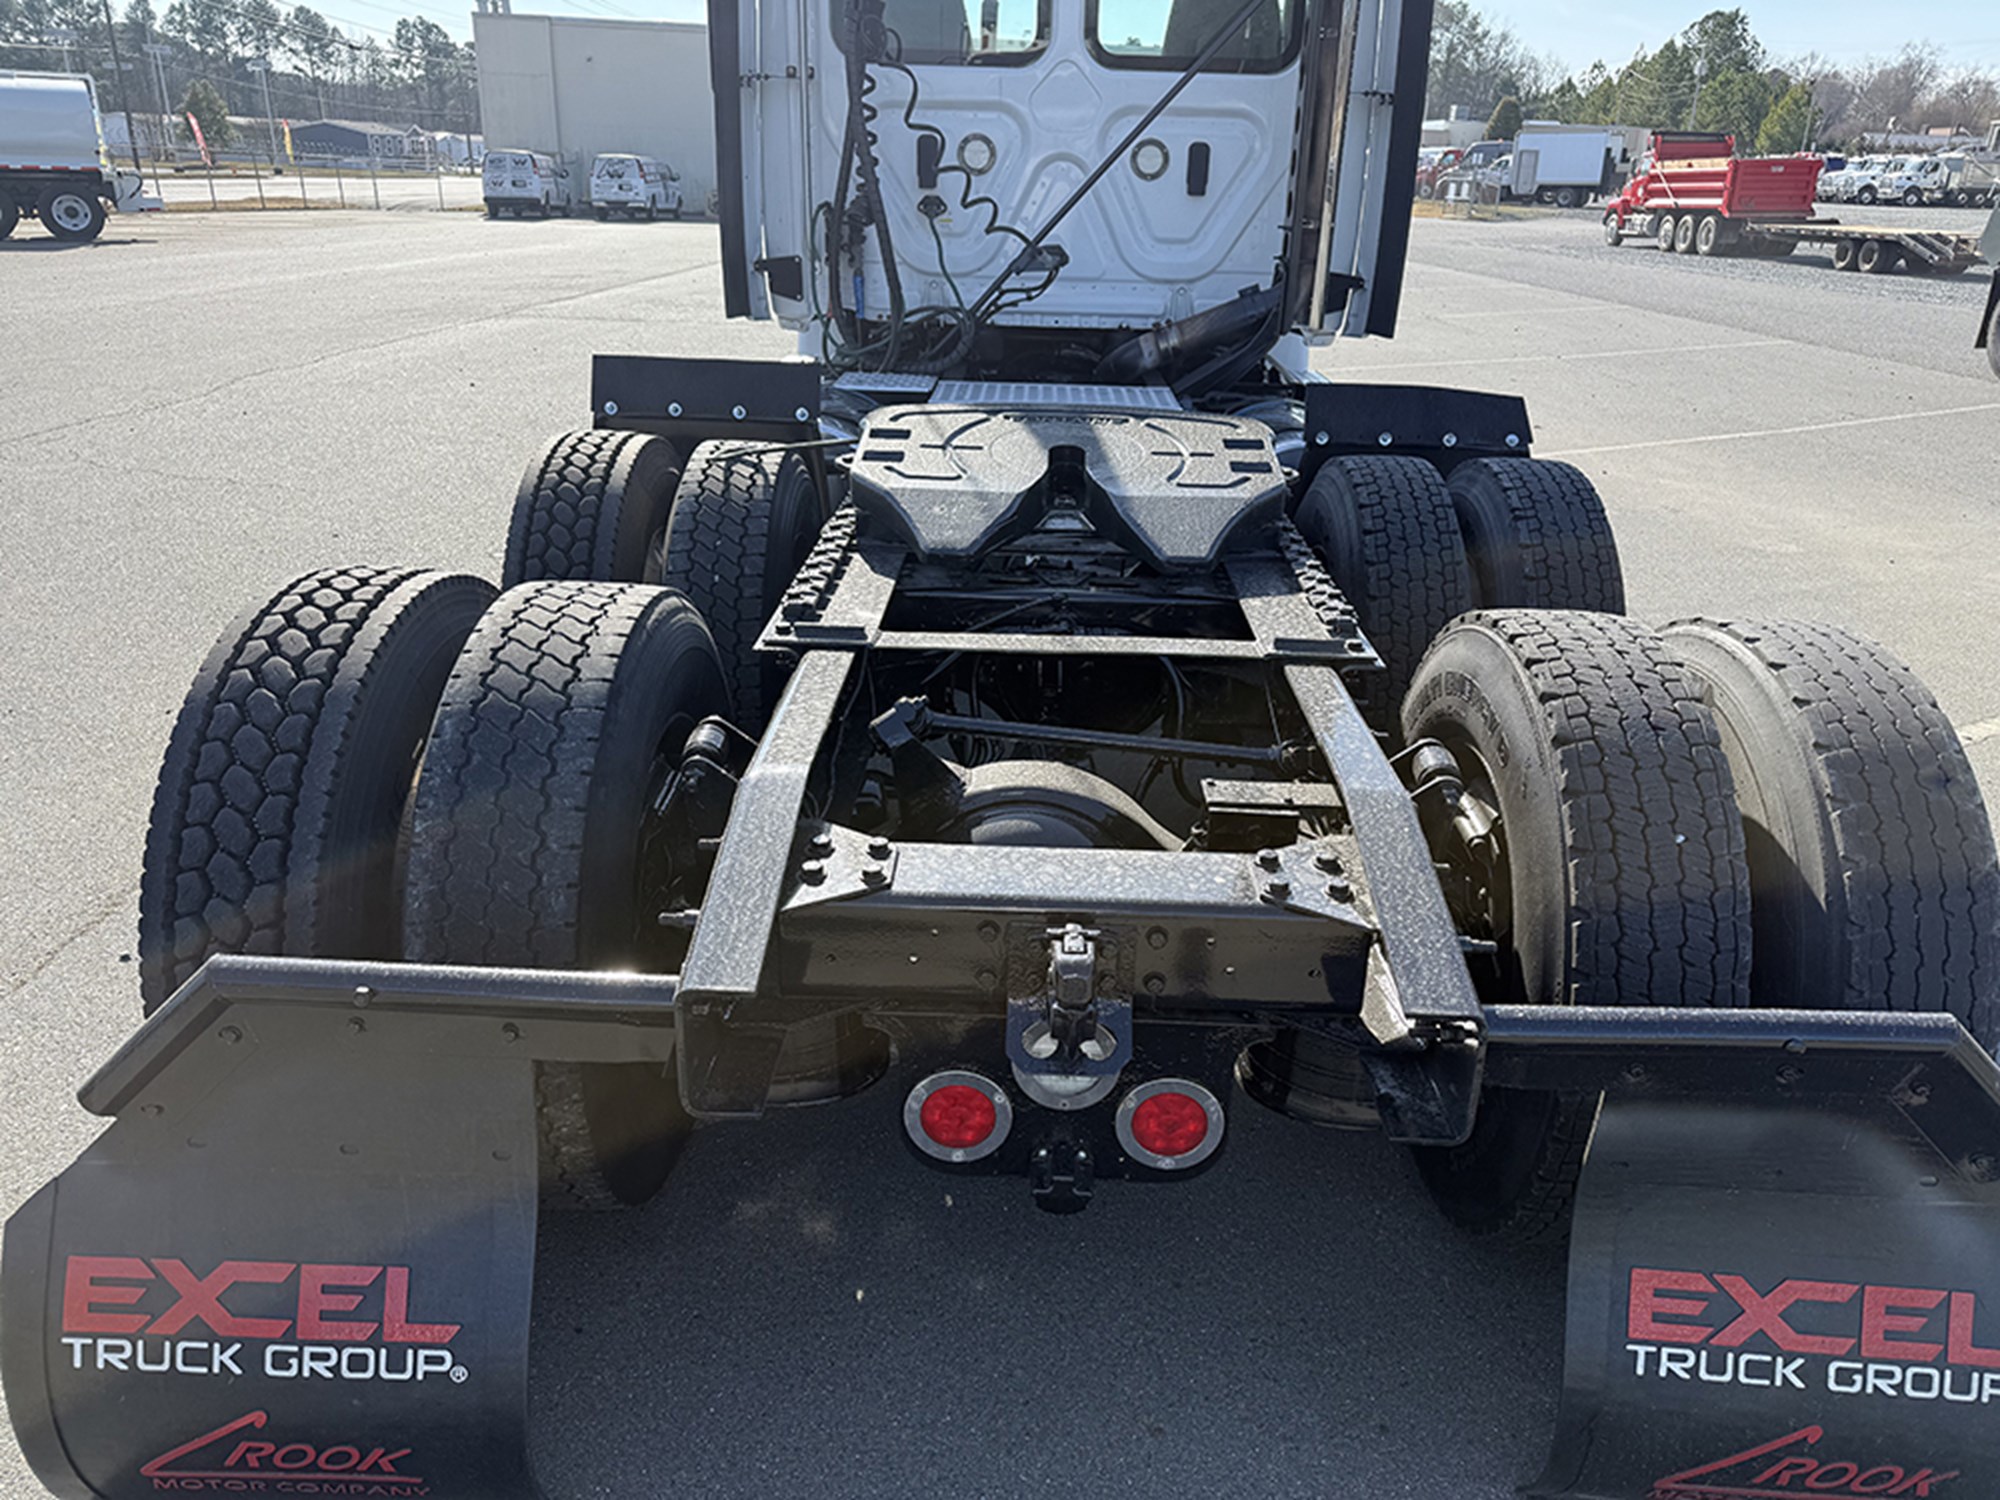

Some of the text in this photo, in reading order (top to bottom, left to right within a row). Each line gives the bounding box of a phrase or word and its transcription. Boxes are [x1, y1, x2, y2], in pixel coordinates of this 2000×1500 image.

[62, 1255, 461, 1343] EXCEL
[1627, 1267, 2000, 1368] EXCEL
[61, 1337, 245, 1375] TRUCK
[1626, 1343, 1806, 1389] TRUCK
[152, 1478, 431, 1498] MOTOR COMPANY
